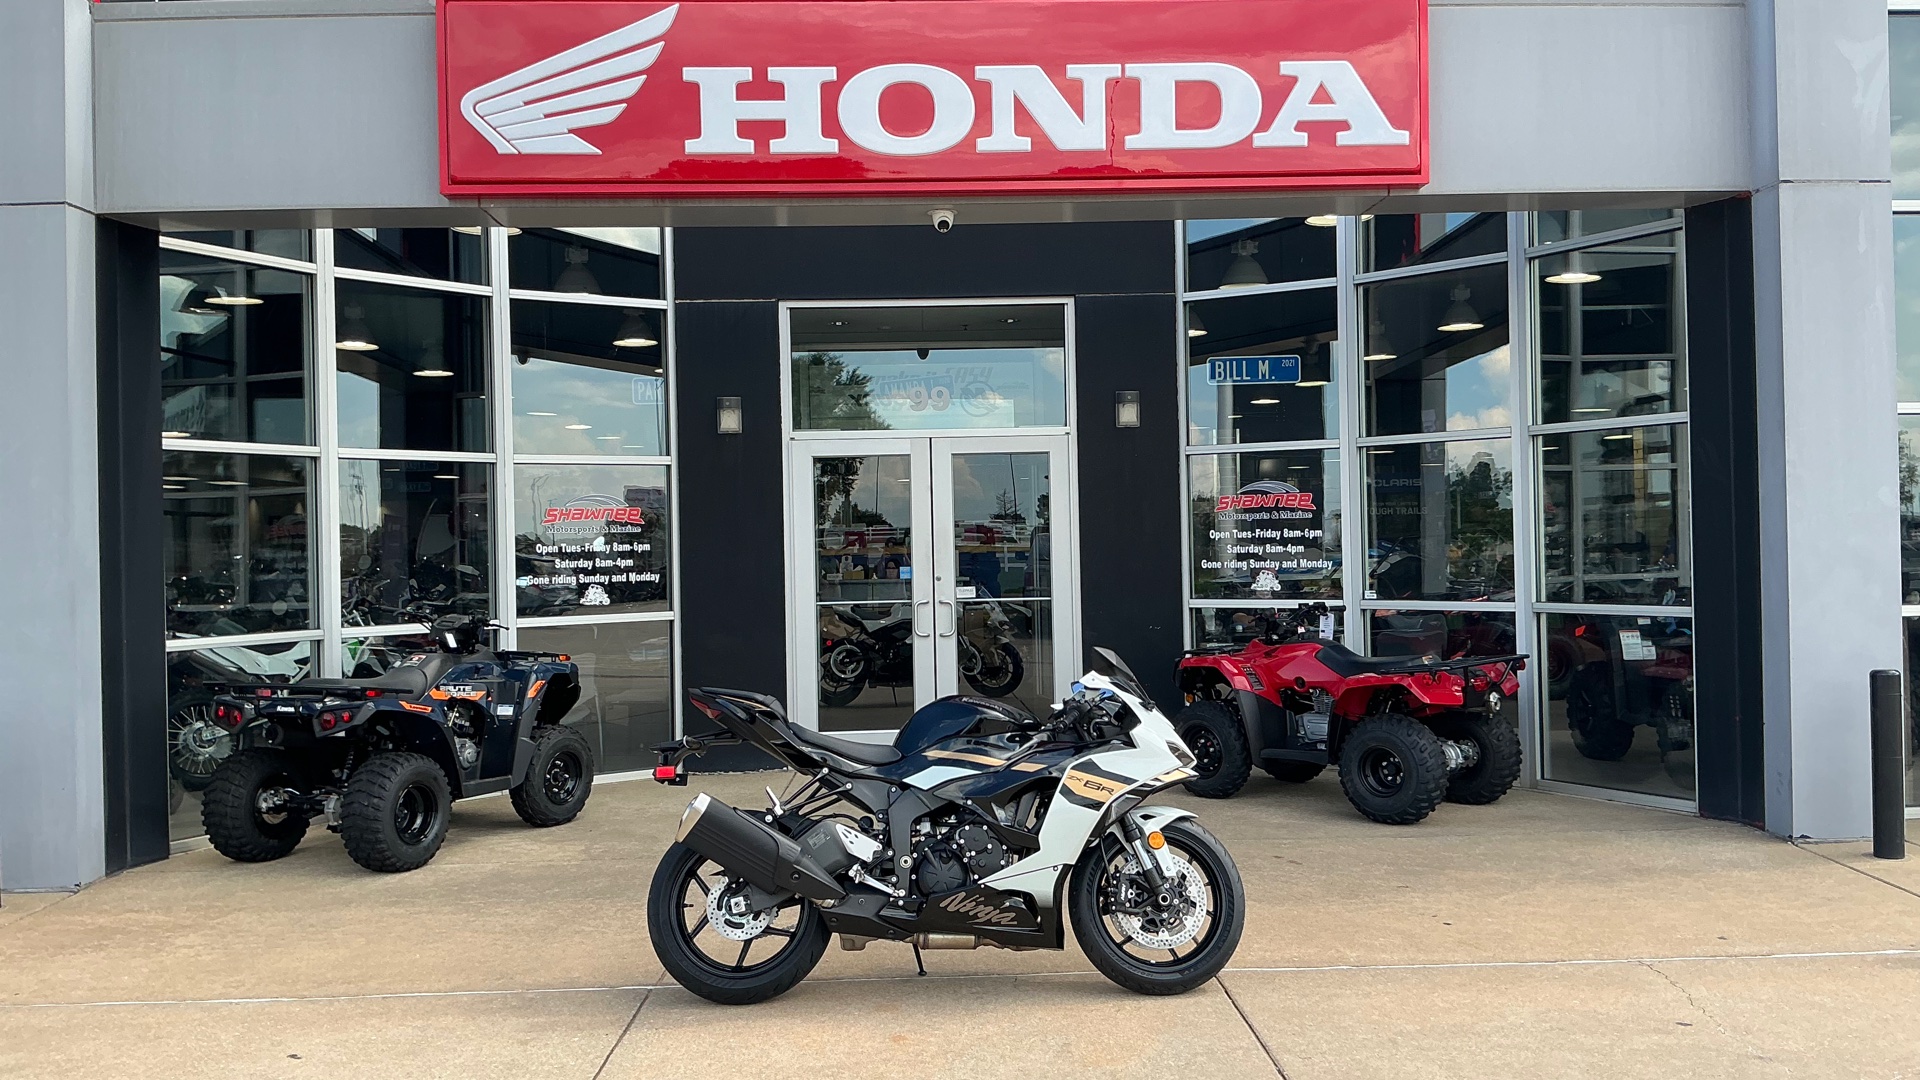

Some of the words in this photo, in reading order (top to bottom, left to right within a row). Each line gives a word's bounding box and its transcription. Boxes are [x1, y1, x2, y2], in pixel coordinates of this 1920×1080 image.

[682, 60, 1410, 155] HONDA
[1281, 359, 1295, 367] 2021
[1215, 360, 1251, 381] BILL
[909, 386, 951, 412] 99
[1218, 511, 1270, 521] Motorsports
[1271, 511, 1279, 519] &
[1280, 510, 1312, 519] Marine
[1367, 507, 1394, 515] OUGH
[546, 525, 600, 535] Motorsports
[601, 525, 609, 533] &
[610, 525, 641, 533] Marine
[1209, 530, 1231, 541] Open
[1232, 529, 1281, 540] Tues-Friday
[1283, 528, 1323, 539] 8am-6pm
[536, 544, 558, 555] Open
[561, 542, 610, 554] Tues-Friay
[612, 542, 651, 553] 8am-6pm
[1226, 544, 1263, 555] Saturday
[1265, 543, 1304, 554] 8am-4pm
[555, 558, 594, 569] Saturday
[595, 557, 634, 568] 8am-4pm
[1201, 560, 1222, 569] Gone
[1224, 559, 1247, 570] riding
[1249, 559, 1279, 570] Sunday
[1281, 559, 1297, 568] and
[1299, 558, 1333, 569] Monday
[527, 575, 549, 584] Gone
[552, 573, 577, 585] riding
[578, 573, 610, 584] Sunday
[611, 573, 626, 582] and
[628, 572, 660, 583] Monday
[939, 891, 1019, 924] Ninja
